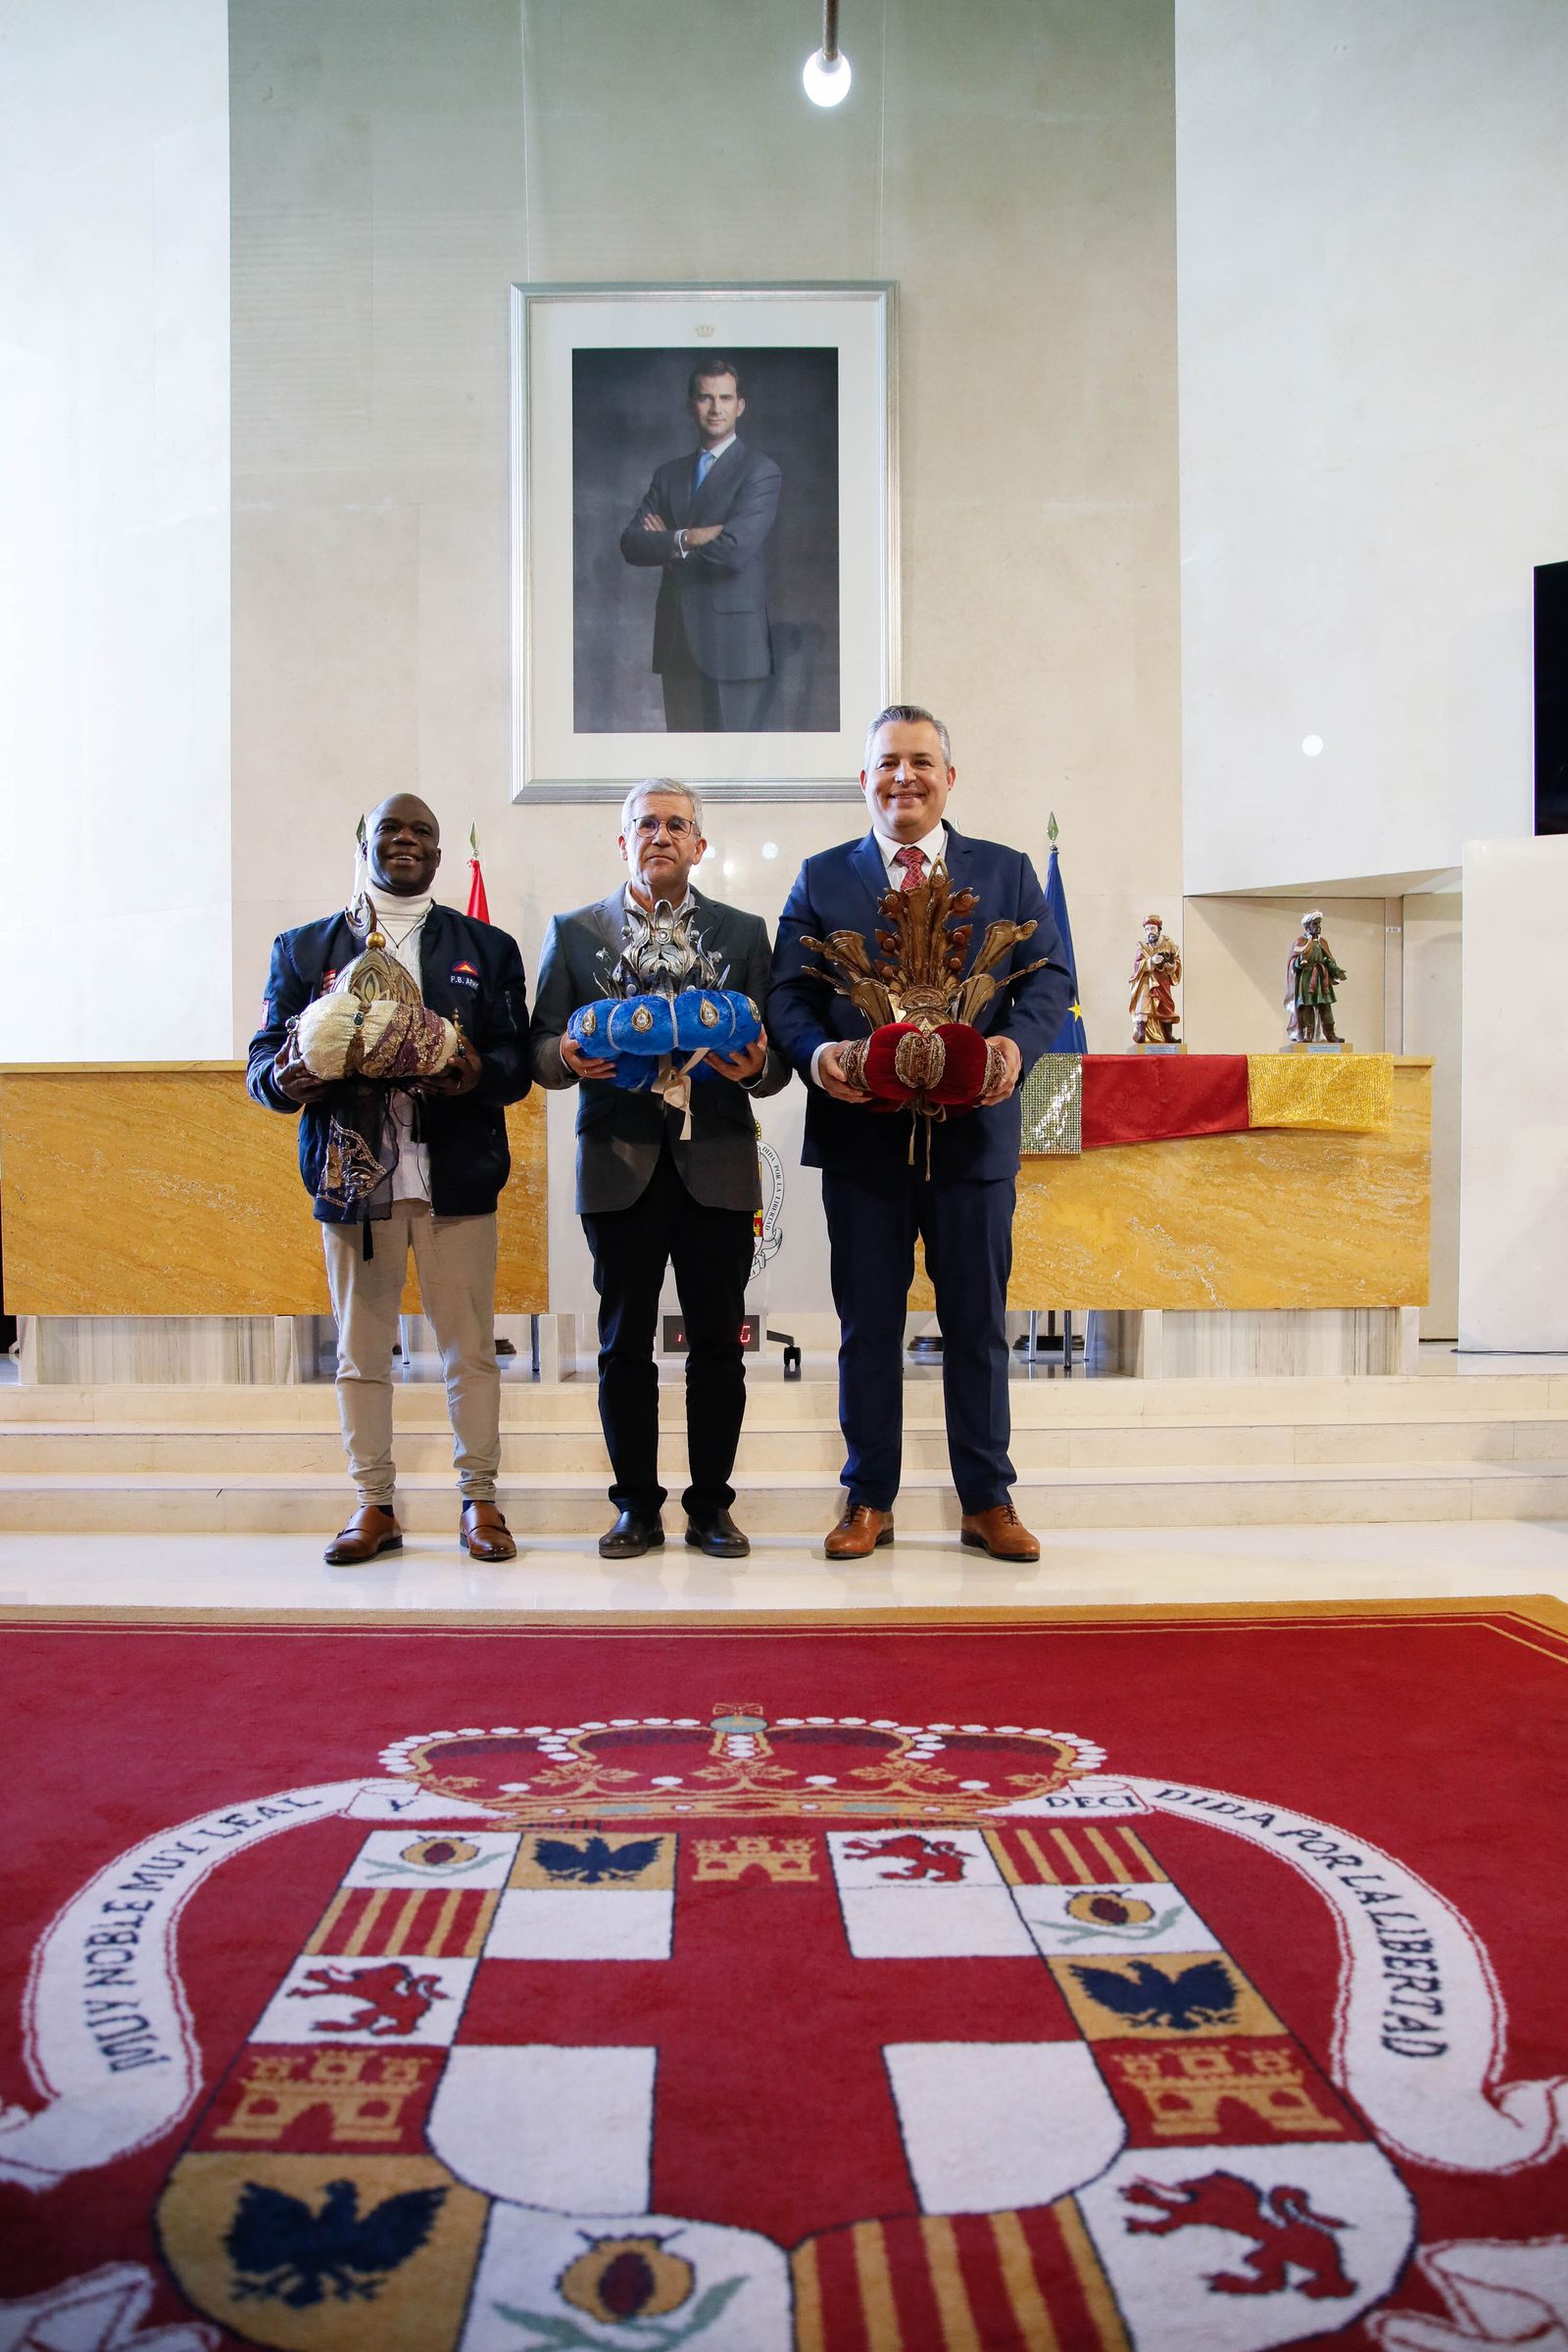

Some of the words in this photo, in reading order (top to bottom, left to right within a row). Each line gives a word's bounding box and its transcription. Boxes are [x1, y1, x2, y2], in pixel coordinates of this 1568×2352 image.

[776, 1182, 782, 1193] LA
[764, 1196, 781, 1231] LIBERTAD
[196, 1796, 323, 1839] LEAL
[119, 1841, 210, 1893] MUY
[1274, 1829, 1363, 1870] POR
[1338, 1874, 1403, 1905] LA
[84, 1899, 154, 1988] NOBLE
[1366, 1909, 1449, 2058] LIBERTAD
[84, 1999, 171, 2074] MUY
